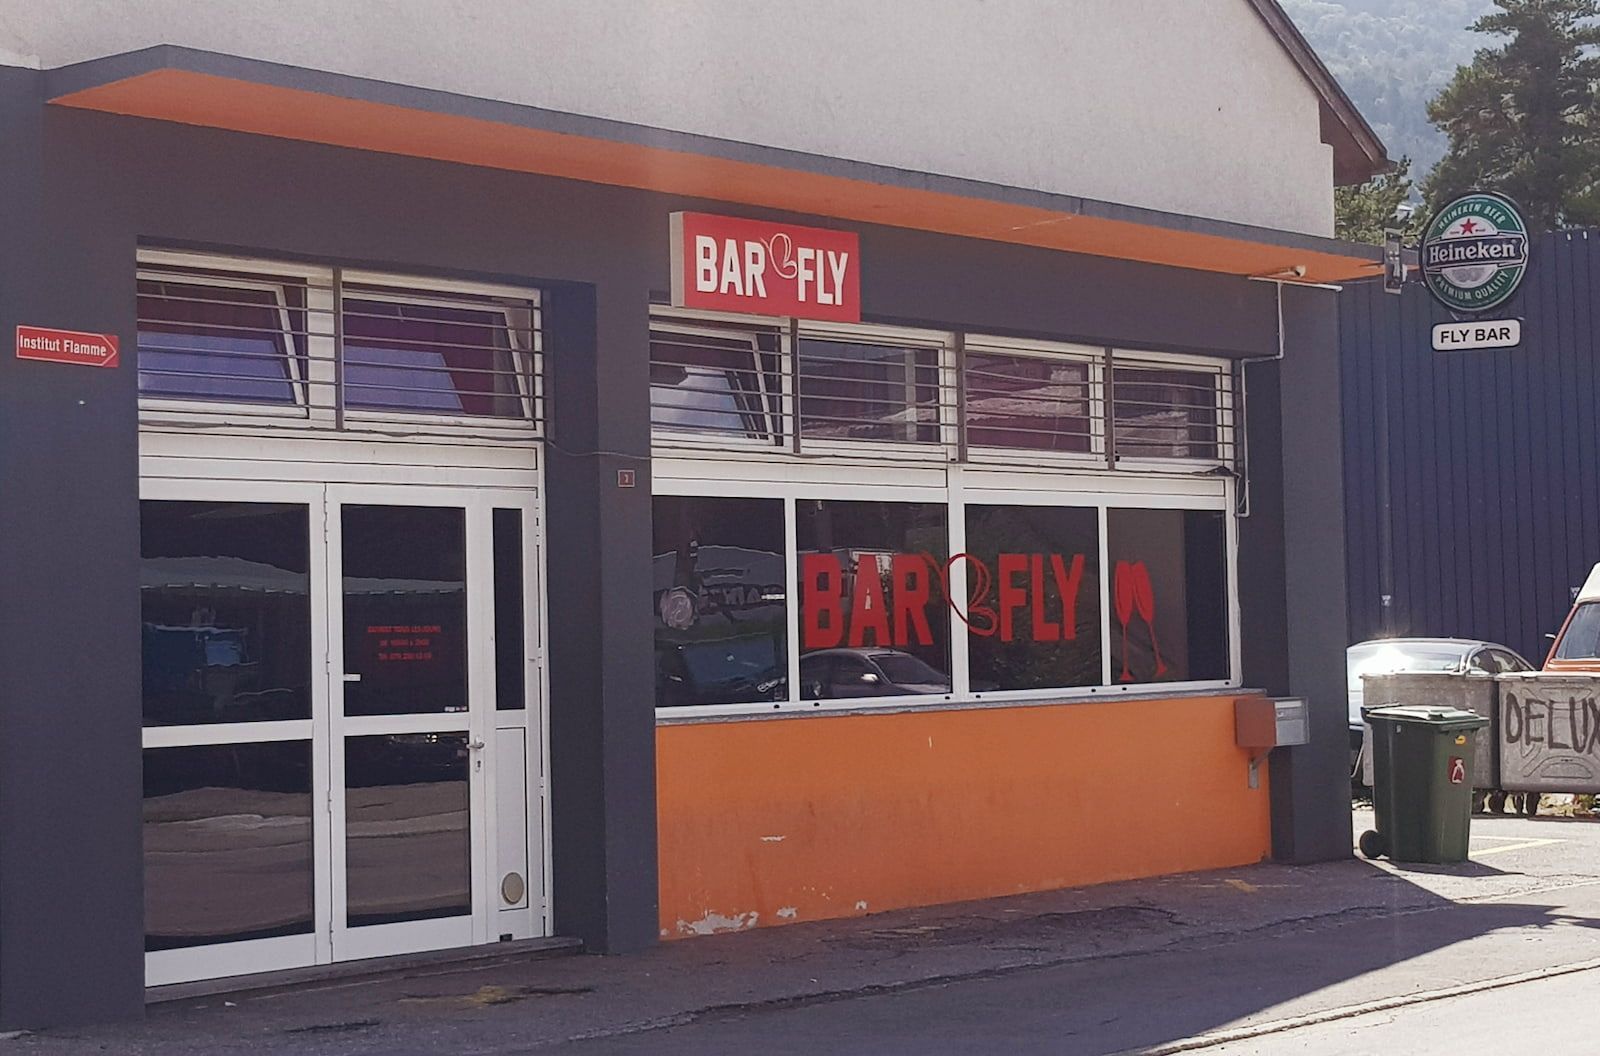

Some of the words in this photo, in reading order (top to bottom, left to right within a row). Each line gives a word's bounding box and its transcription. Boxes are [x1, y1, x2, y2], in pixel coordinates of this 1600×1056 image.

[1438, 203, 1482, 229] HEINEKEN
[1484, 205, 1506, 224] BEER
[1429, 240, 1516, 264] Heineken
[696, 235, 767, 298] BAR
[797, 247, 849, 306] FLY
[1435, 275, 1472, 300] PREMIUM
[1475, 270, 1510, 299] QUALITY
[20, 334, 61, 352] Institut
[63, 339, 107, 356] Flamme
[1440, 329, 1470, 344] FLY
[1475, 327, 1511, 342] BAR
[803, 553, 934, 648] BAR
[1000, 554, 1085, 642] FLY
